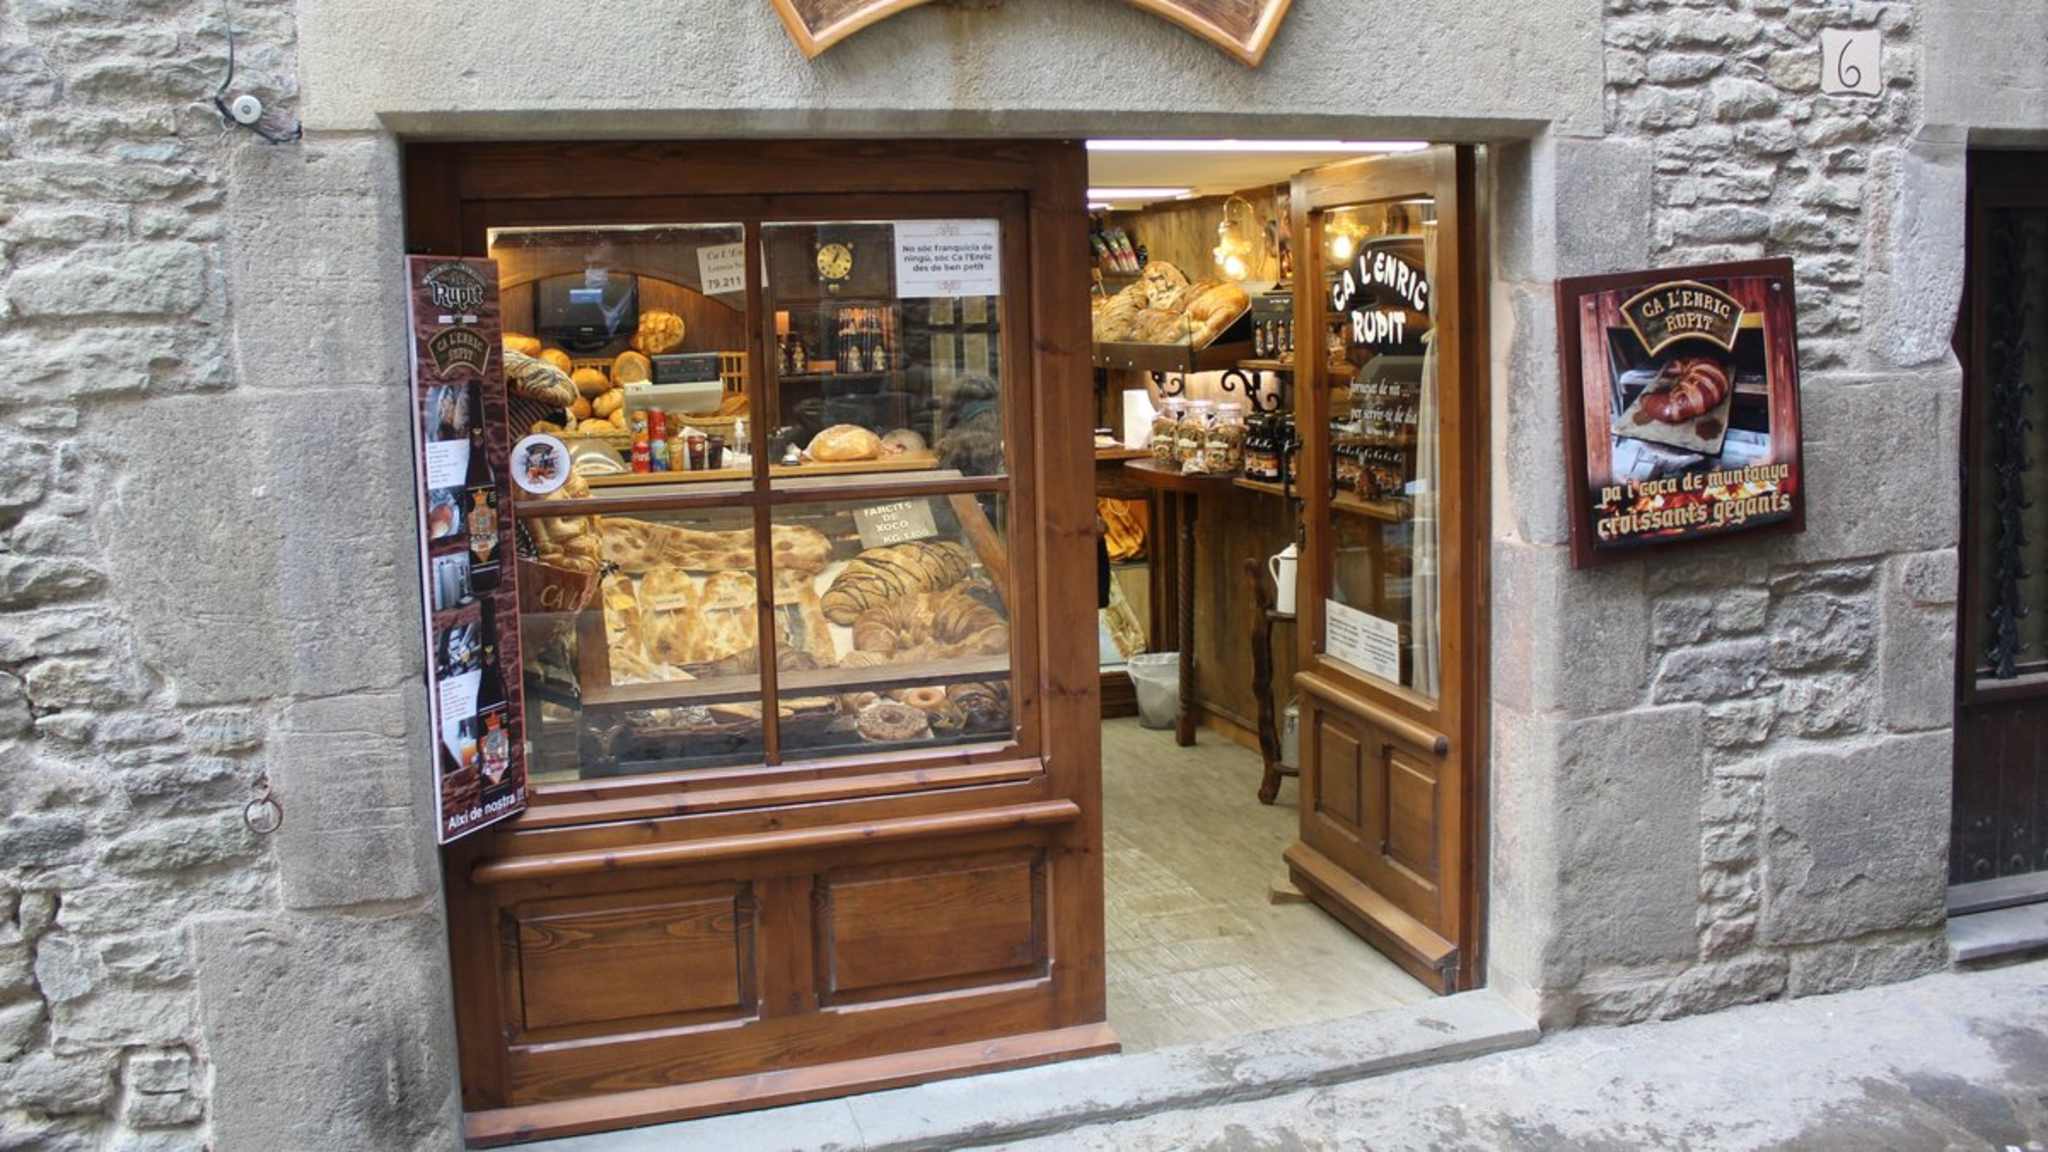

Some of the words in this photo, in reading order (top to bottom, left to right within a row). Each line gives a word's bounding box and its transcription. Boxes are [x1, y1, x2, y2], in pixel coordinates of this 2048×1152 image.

[1838, 38, 1862, 89] 6
[1333, 269, 1356, 311] CA
[1360, 250, 1429, 311] L'ENRIC
[1642, 297, 1664, 318] CA
[1667, 289, 1731, 319] L'ENRIC
[1665, 312, 1713, 332] RUPIT
[1351, 310, 1406, 344] RUPIT
[1594, 485, 1621, 509] pa
[1627, 480, 1633, 499] i
[1640, 478, 1676, 496] coca
[1683, 472, 1703, 491] de
[1707, 463, 1790, 485] muntanya
[1597, 502, 1708, 539] croissants
[1712, 493, 1791, 527] gegants
[470, 806, 483, 820] de
